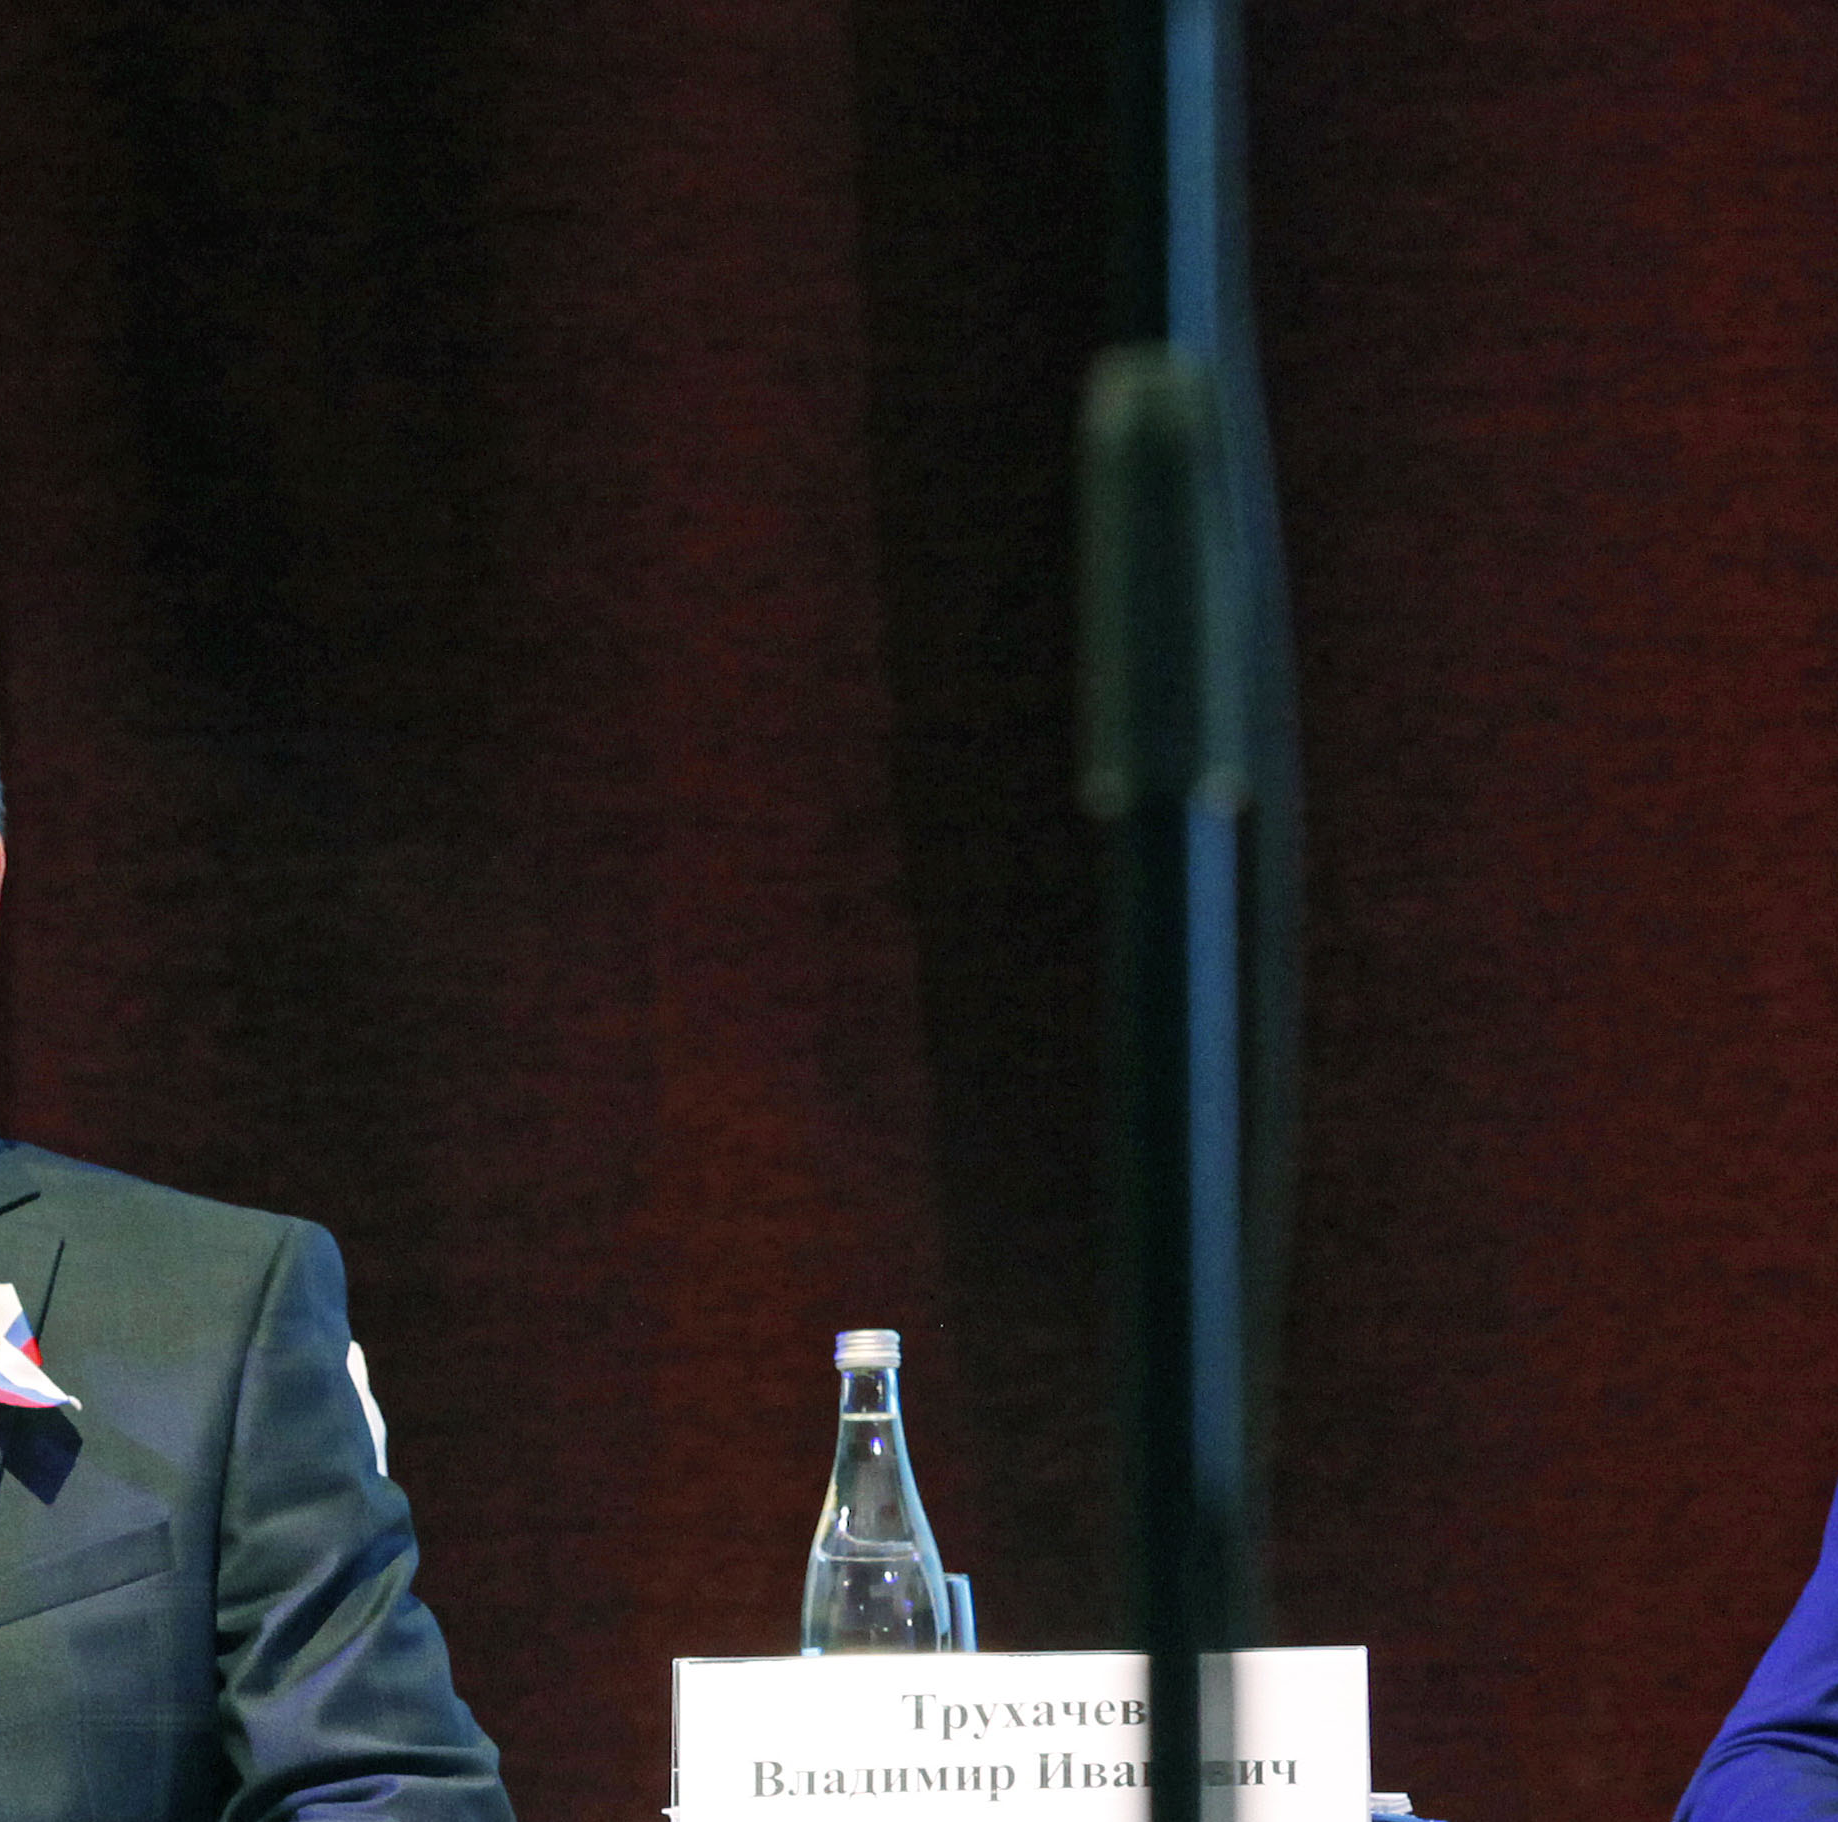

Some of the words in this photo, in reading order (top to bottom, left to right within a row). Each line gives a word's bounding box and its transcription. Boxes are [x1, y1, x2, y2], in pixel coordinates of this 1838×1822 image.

[902, 1693, 1147, 1740] Трухачев
[753, 1760, 1016, 1802] Владимир
[1038, 1751, 1298, 1789] Иваич
